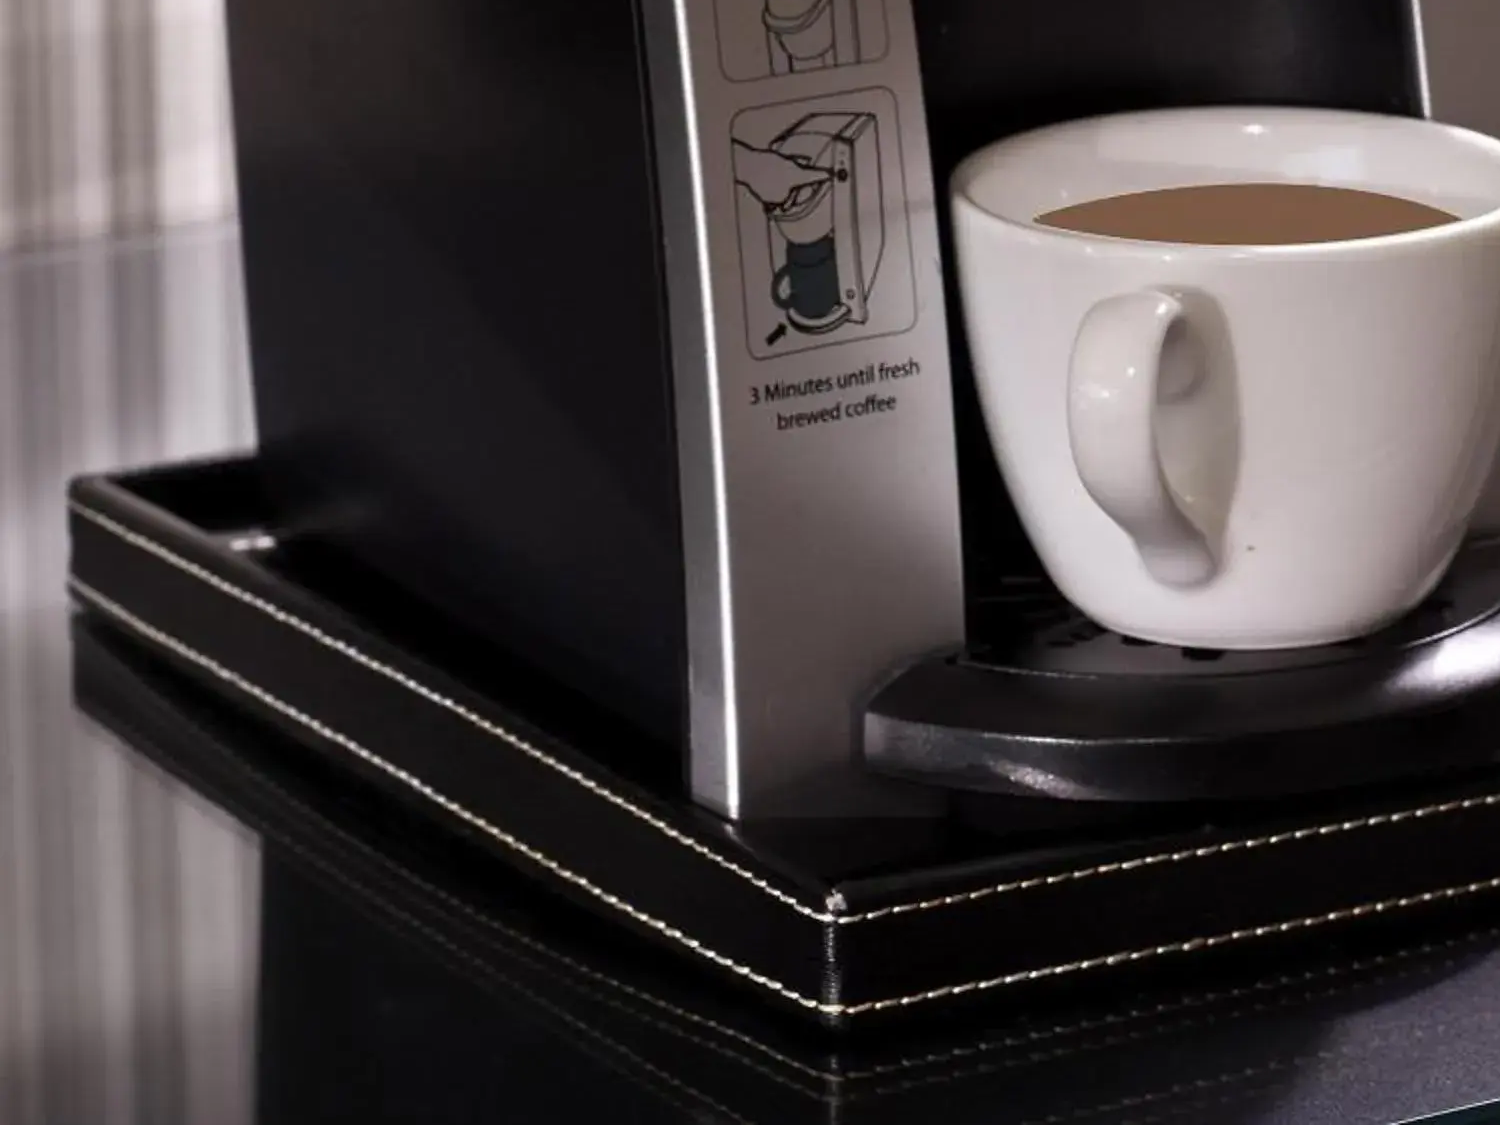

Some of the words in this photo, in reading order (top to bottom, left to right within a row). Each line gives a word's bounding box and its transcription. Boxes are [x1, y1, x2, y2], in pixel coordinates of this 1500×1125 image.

[750, 386, 760, 405] 3
[764, 376, 833, 403] Minutes
[837, 364, 876, 389] until
[878, 357, 921, 381] fresh
[776, 402, 842, 431] brewed
[845, 394, 897, 418] coffee
